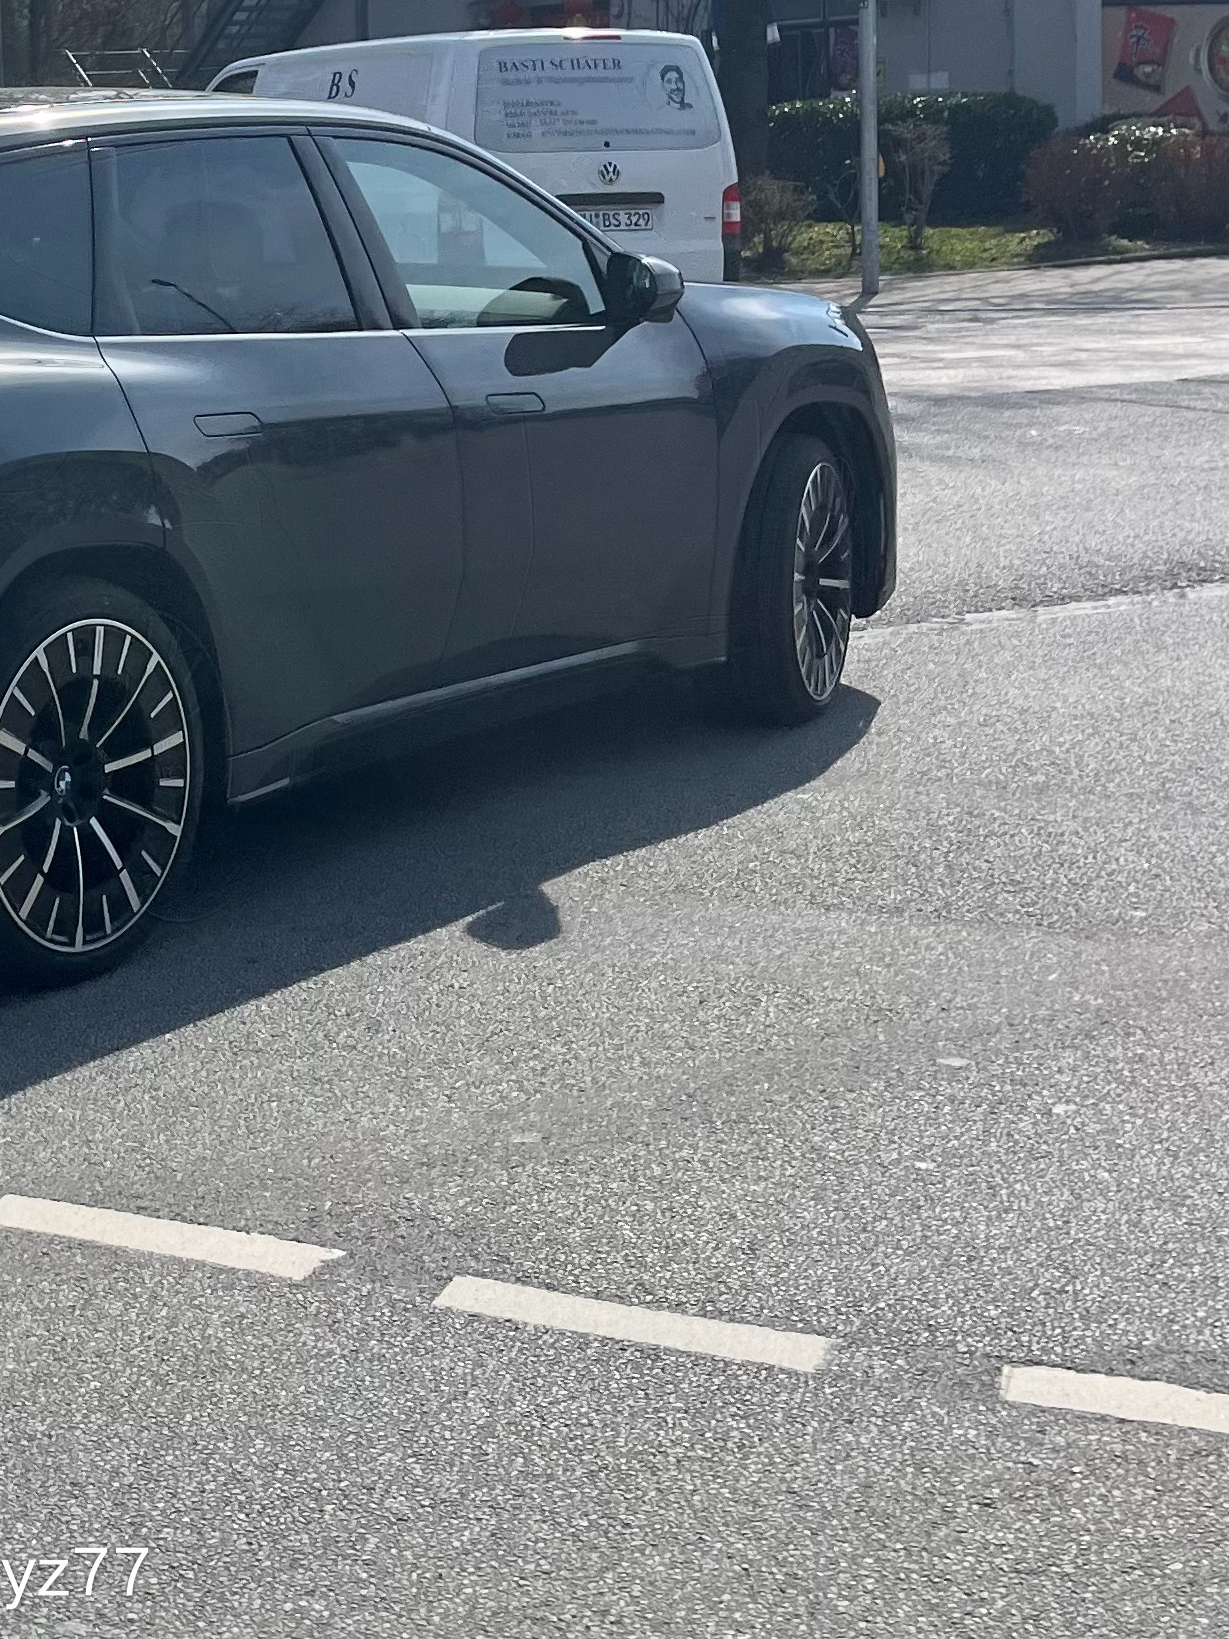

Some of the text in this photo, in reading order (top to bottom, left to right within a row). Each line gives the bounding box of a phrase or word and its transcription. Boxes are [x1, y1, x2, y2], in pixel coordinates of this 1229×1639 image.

[496, 58, 546, 73] BASTI
[602, 211, 622, 228] BS
[624, 211, 651, 227] 329
